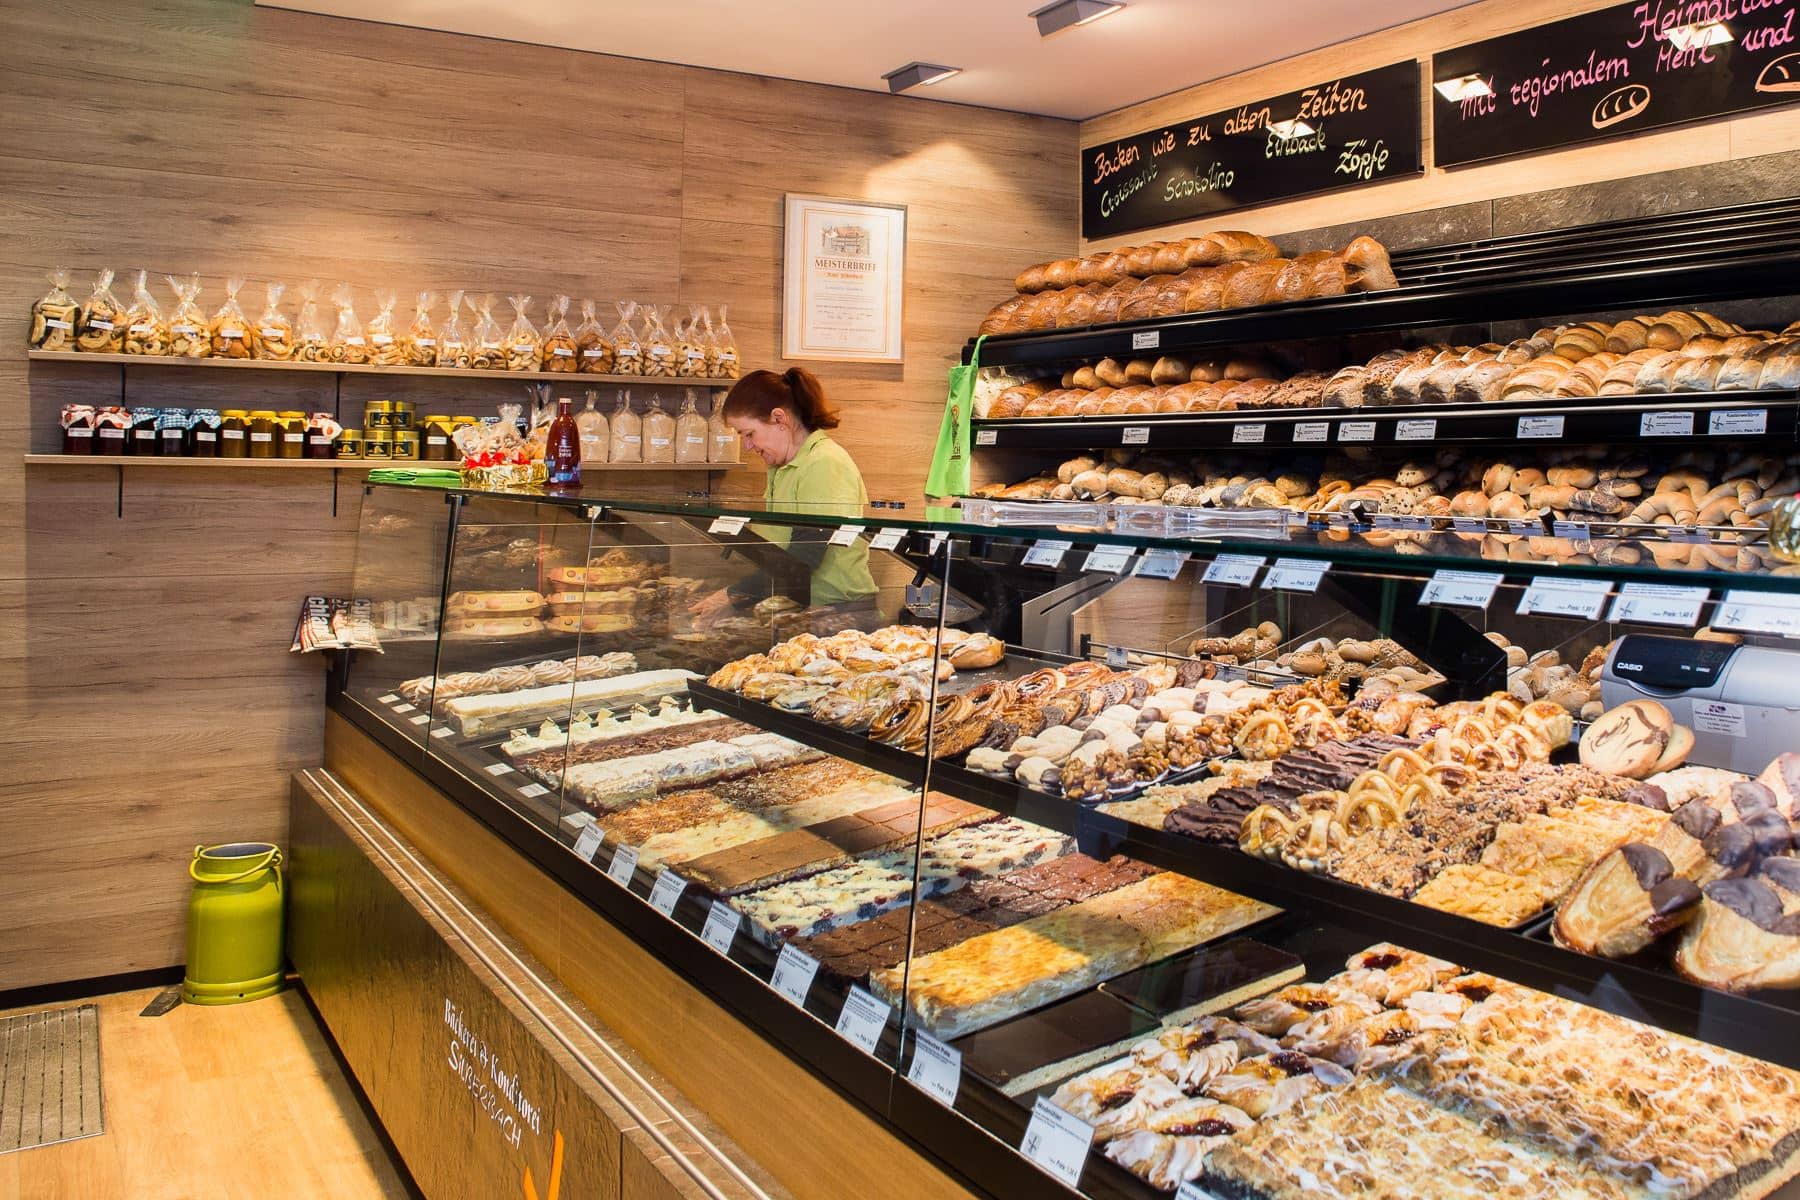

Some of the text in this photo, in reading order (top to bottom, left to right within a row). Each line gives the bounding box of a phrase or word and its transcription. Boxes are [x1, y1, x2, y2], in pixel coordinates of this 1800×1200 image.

[1510, 49, 1630, 117] regionalem
[1656, 29, 1716, 72] Mehl
[1741, 8, 1795, 51] und
[1093, 80, 1367, 184] Backen wie zu alten Zeiten
[1335, 138, 1389, 180] Zöpfe
[815, 259, 876, 272] MEISTERBRIEF
[1617, 662, 1643, 672] CASIO
[444, 998, 477, 1057] Bäckerei
[491, 1053, 541, 1135] Konditorei
